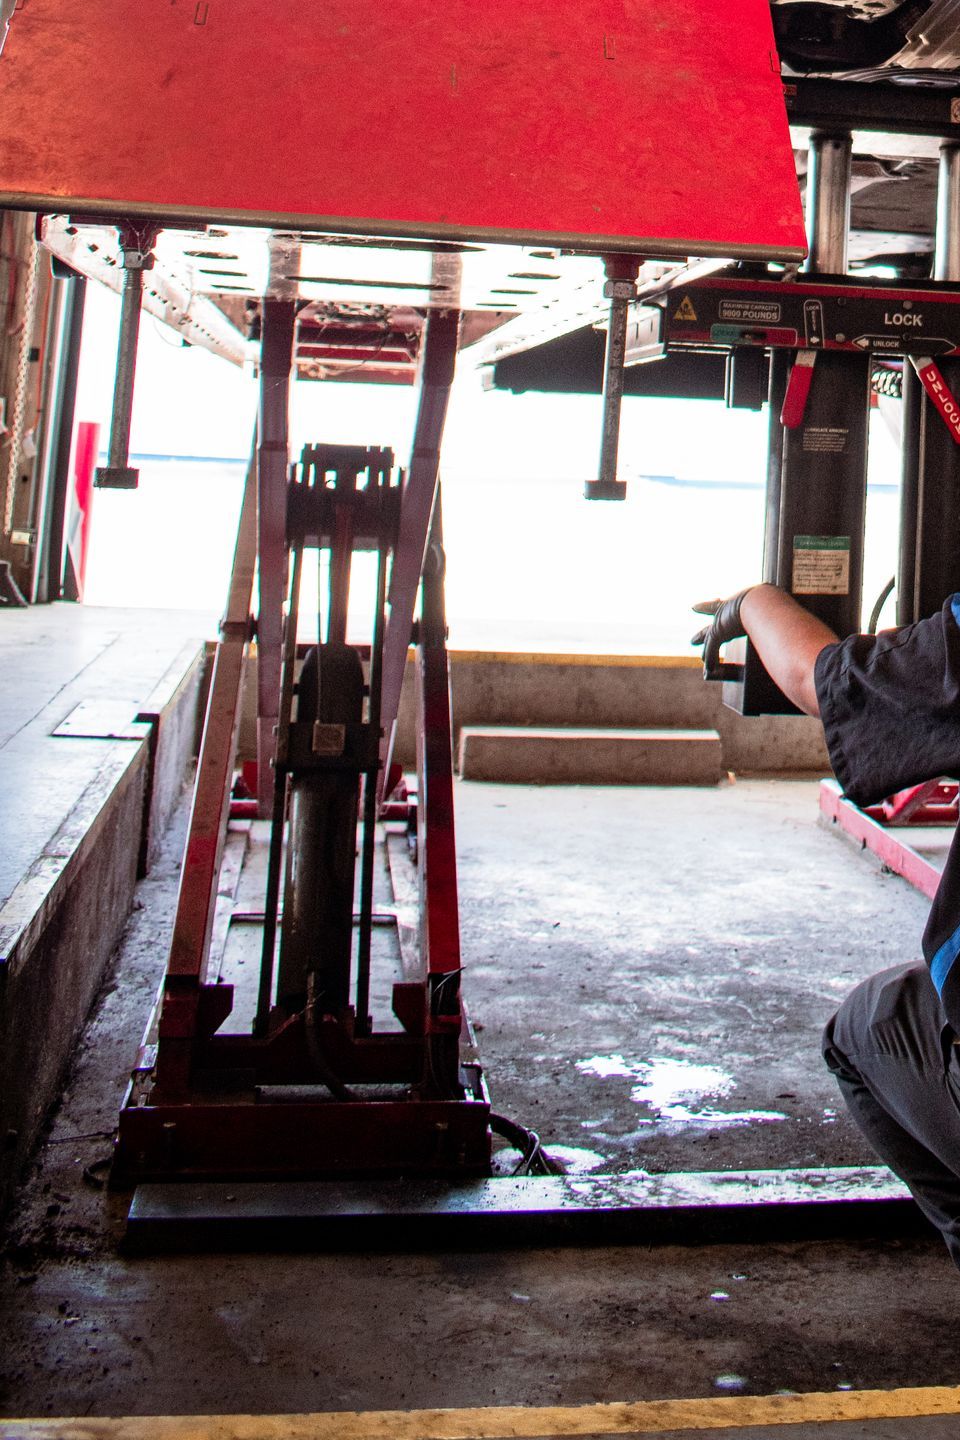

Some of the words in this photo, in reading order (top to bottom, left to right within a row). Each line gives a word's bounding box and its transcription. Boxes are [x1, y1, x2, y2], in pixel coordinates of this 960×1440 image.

[722, 302, 750, 310] MAXIMUM
[742, 311, 778, 320] POUNDS
[884, 313, 923, 327] LOCK
[872, 340, 900, 348] UNLOCK
